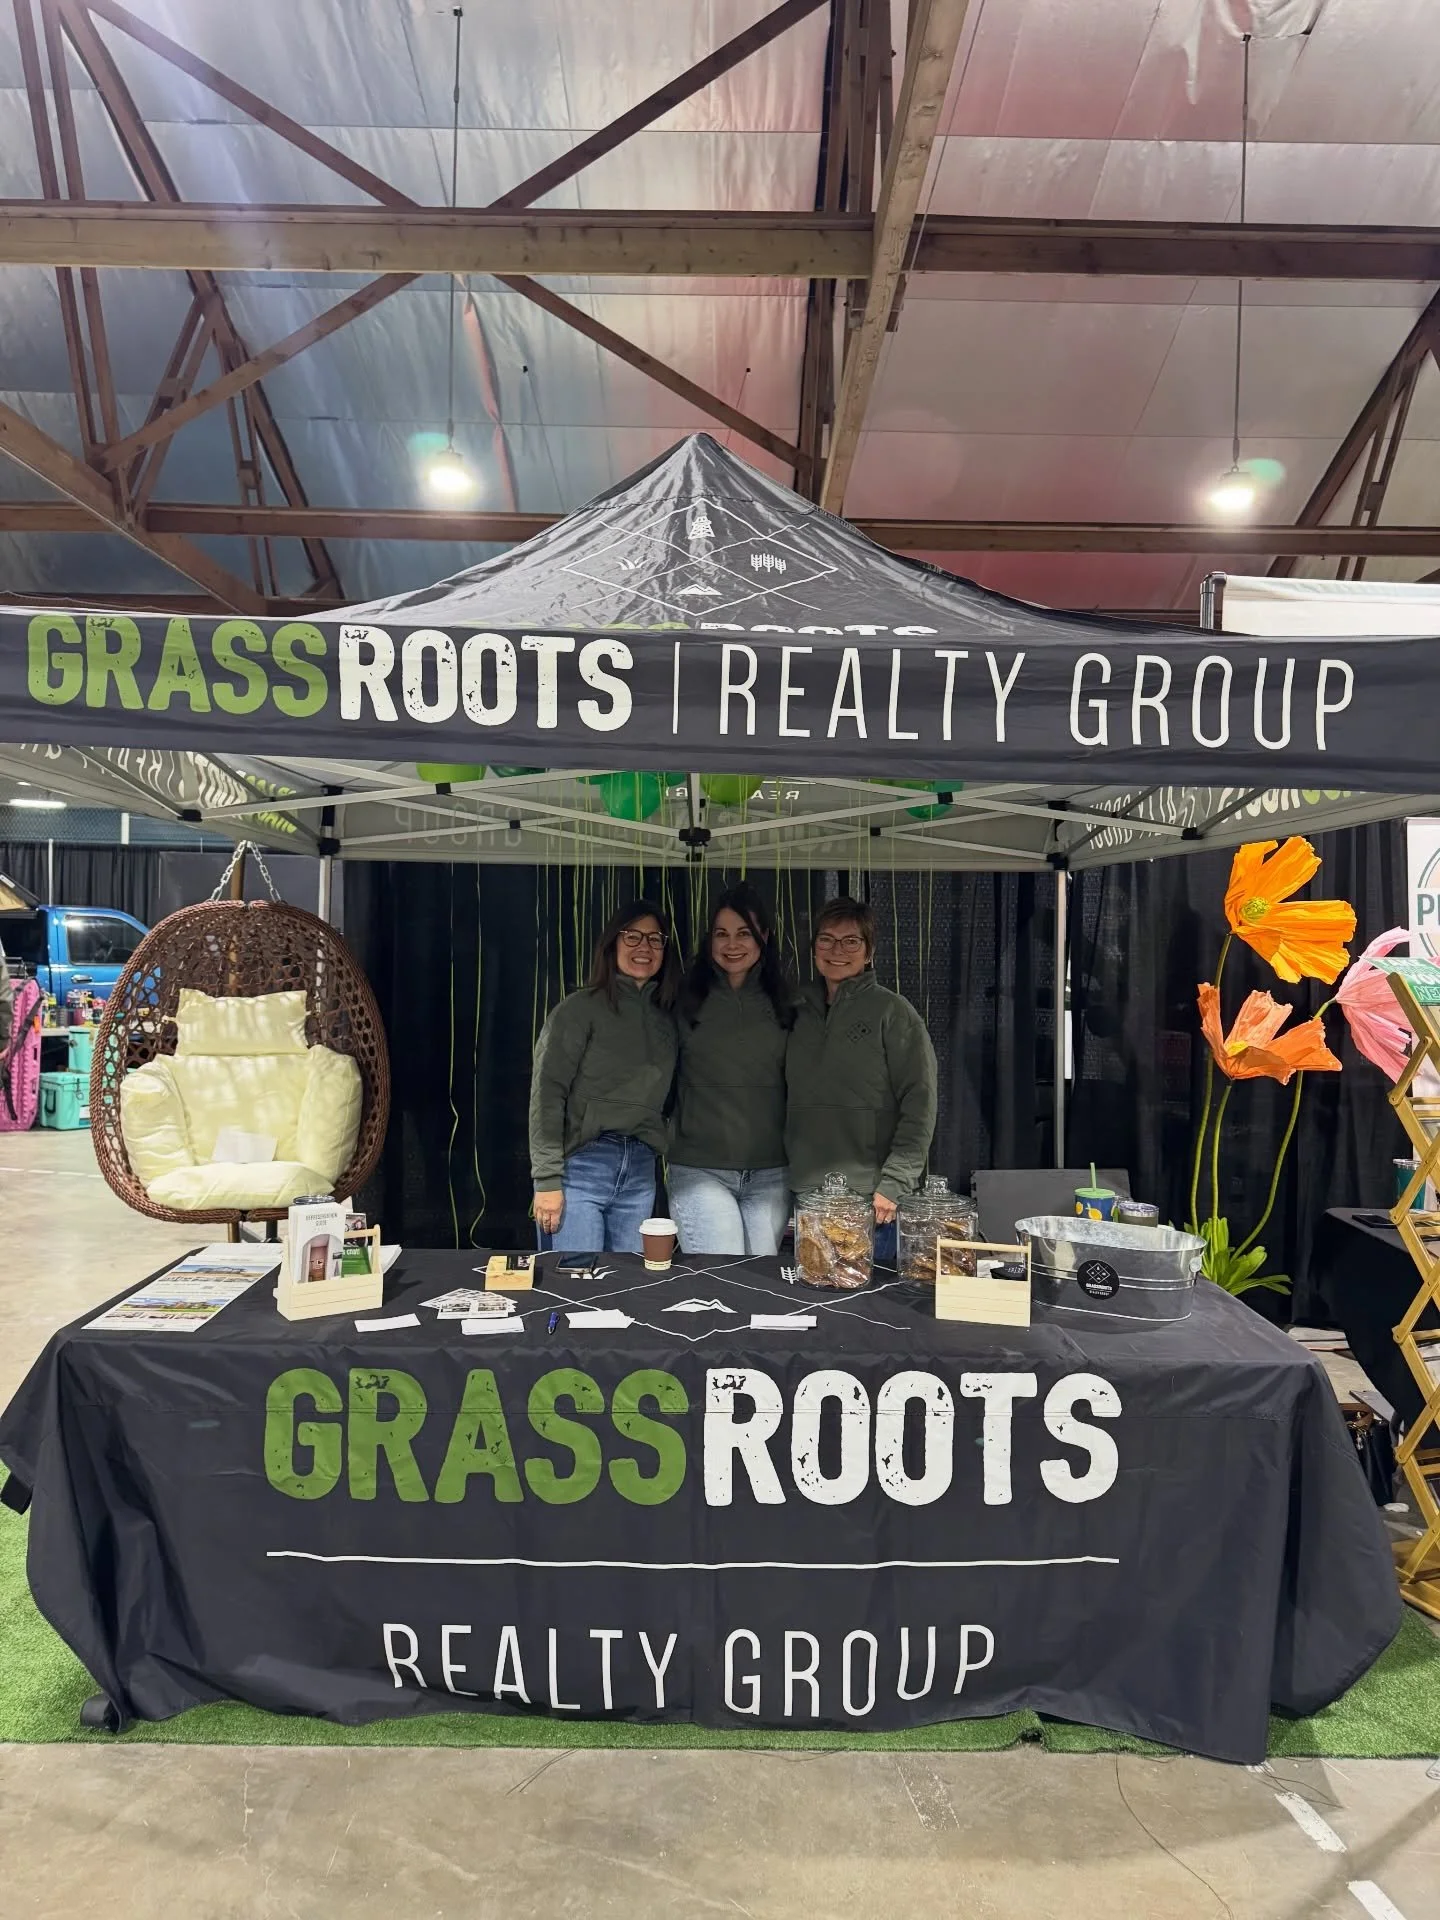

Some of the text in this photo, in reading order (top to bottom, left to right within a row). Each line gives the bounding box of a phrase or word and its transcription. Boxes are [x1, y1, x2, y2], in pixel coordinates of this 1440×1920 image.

[27, 614, 1355, 751] GRASSROOTS REALTY GROUP
[264, 1367, 1123, 1507] GRASSROOTS
[383, 1623, 995, 1718] REALTY GROUP
